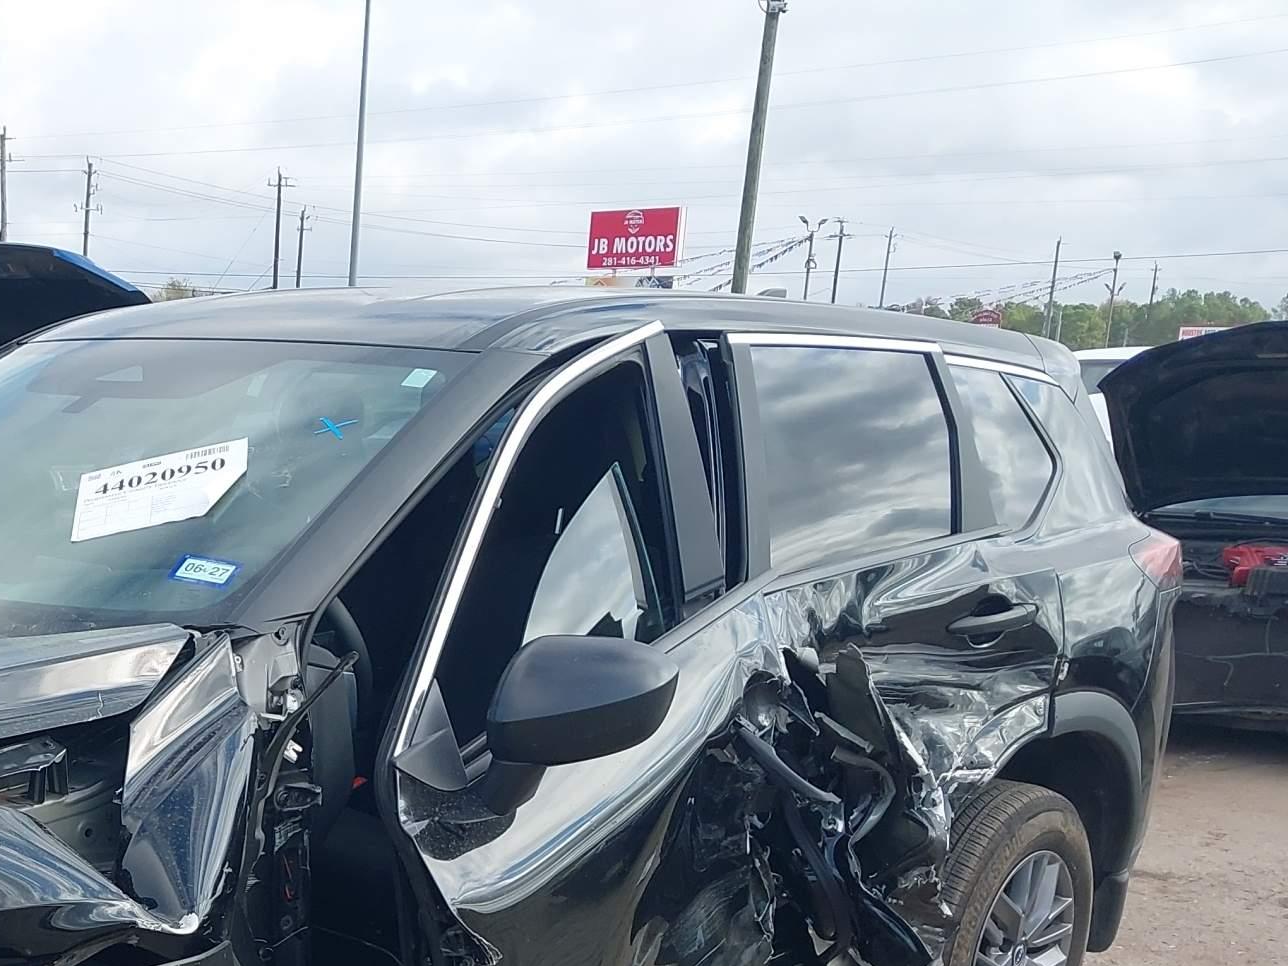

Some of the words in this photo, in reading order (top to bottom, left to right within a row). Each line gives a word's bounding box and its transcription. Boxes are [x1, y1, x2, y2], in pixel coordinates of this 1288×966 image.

[592, 238, 608, 254] JB
[613, 235, 674, 254] MOTORS
[95, 457, 226, 495] 44020950
